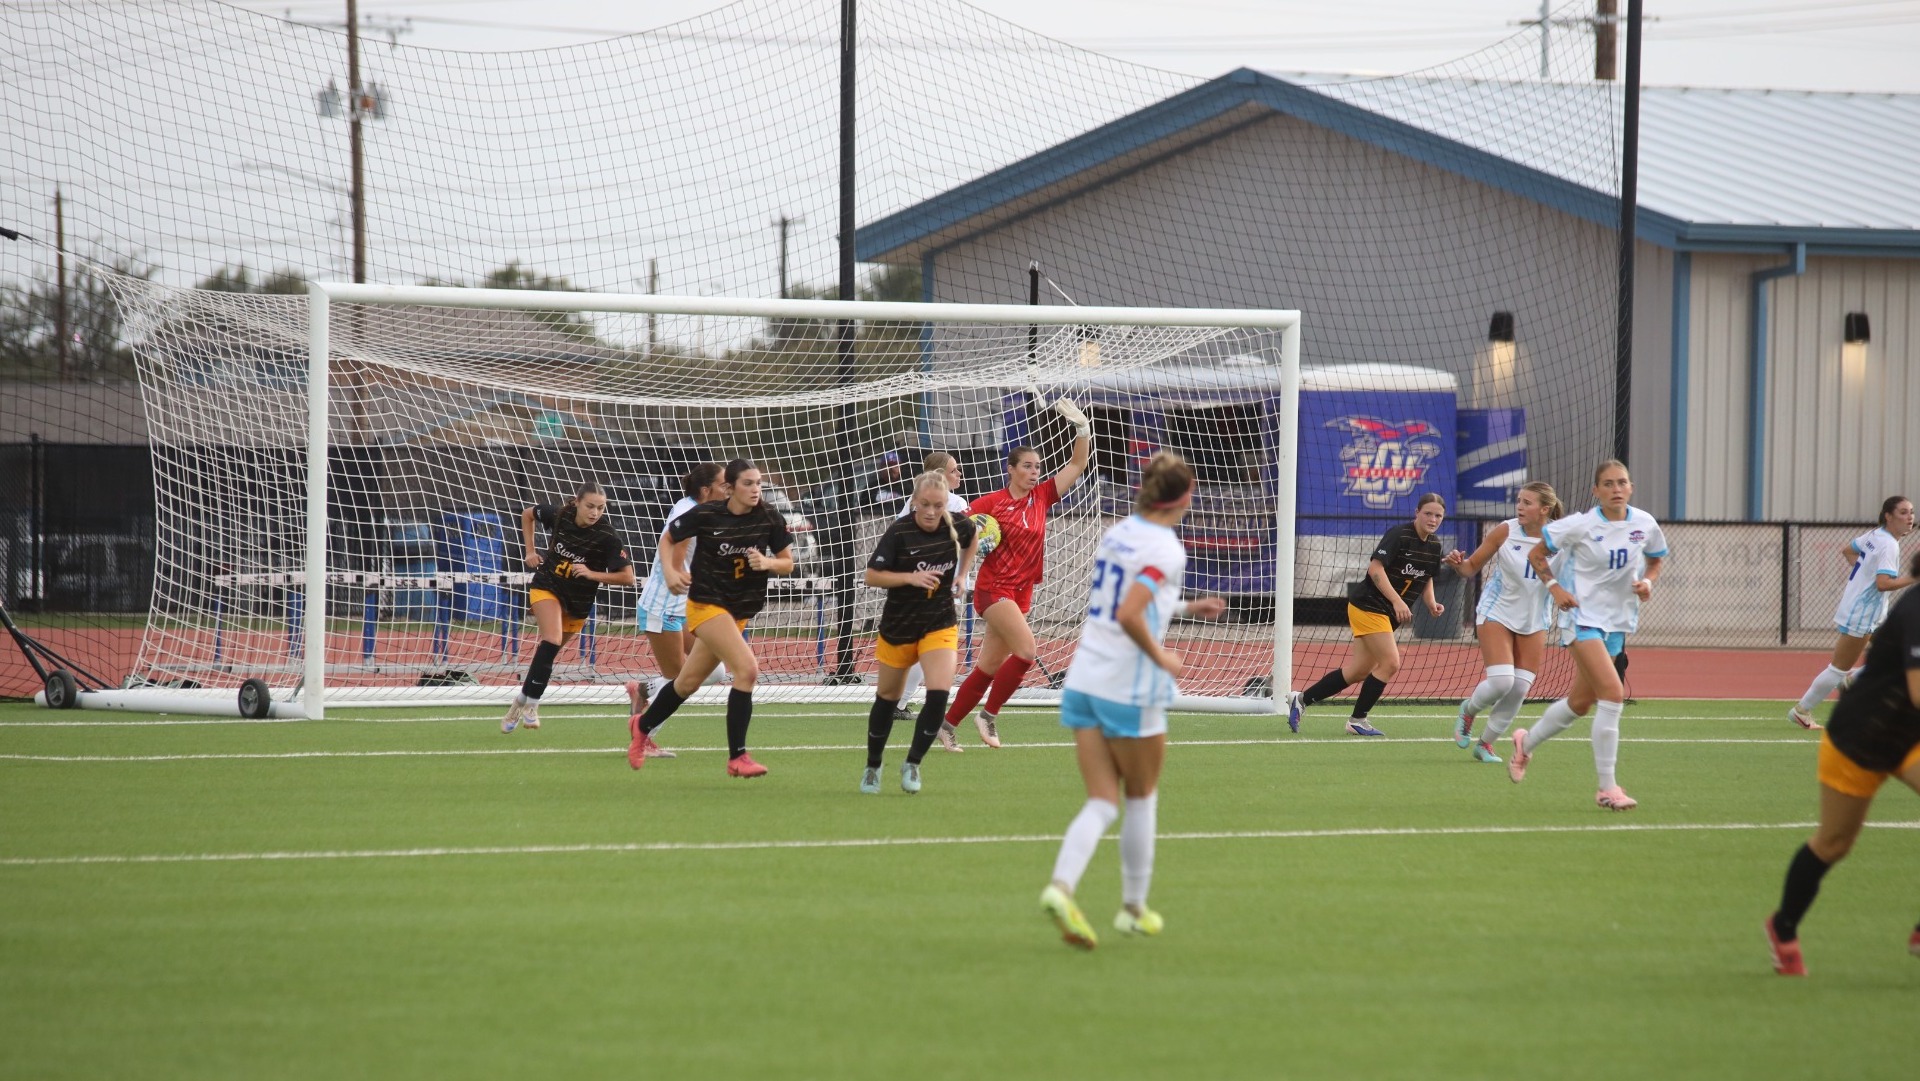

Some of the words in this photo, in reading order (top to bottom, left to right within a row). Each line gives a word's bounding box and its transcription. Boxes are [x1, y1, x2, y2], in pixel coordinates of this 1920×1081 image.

[554, 542, 587, 563] Stangs
[1609, 548, 1628, 570] 10
[733, 558, 745, 579] 2
[1401, 563, 1425, 579] Stangs
